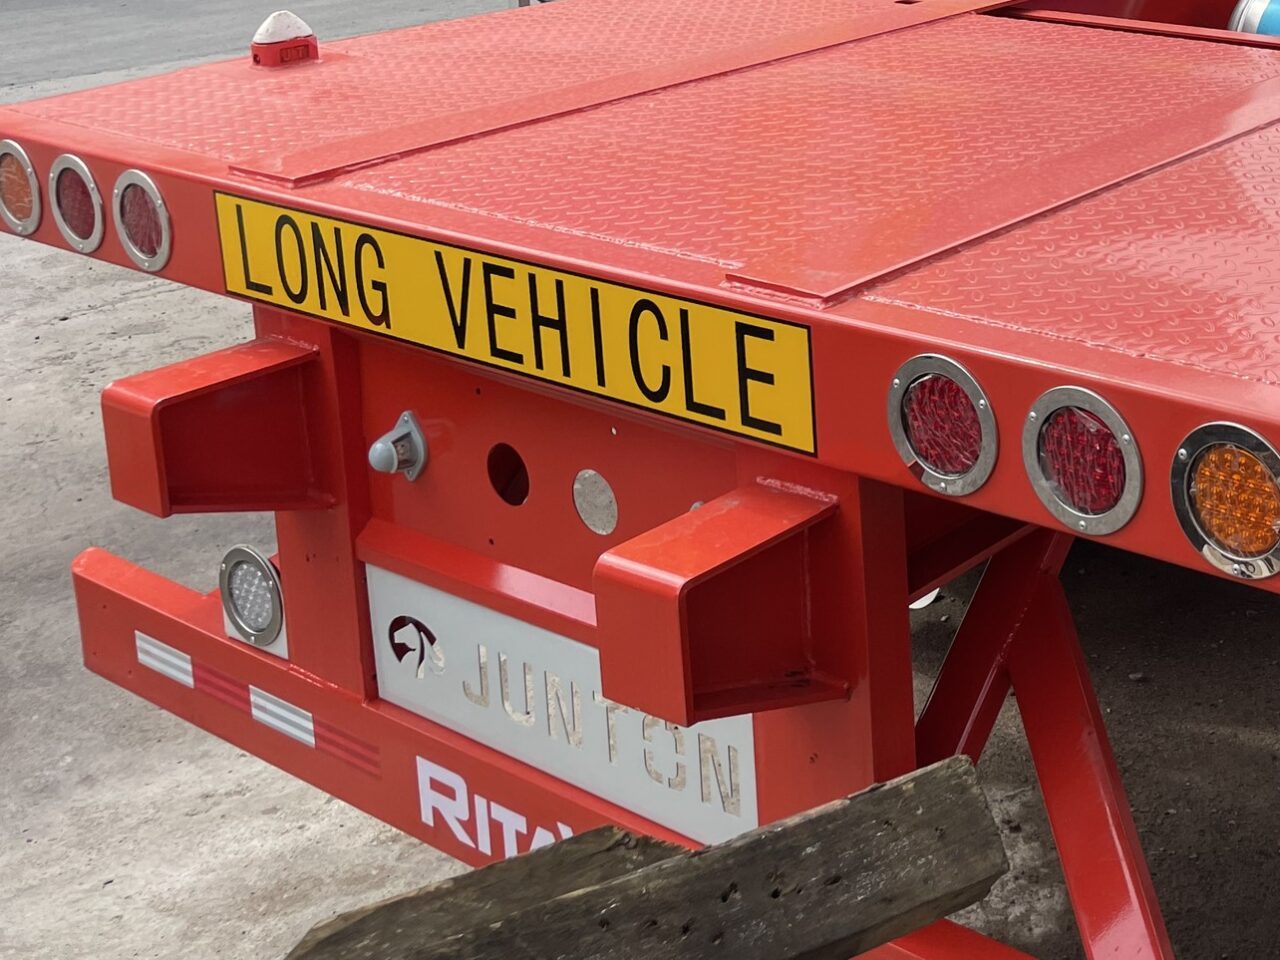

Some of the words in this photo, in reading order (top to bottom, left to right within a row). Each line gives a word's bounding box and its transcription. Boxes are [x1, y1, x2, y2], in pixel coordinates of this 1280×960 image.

[235, 204, 392, 331] LONG
[434, 250, 783, 437] VEHICLE
[463, 643, 742, 818] JUNTON
